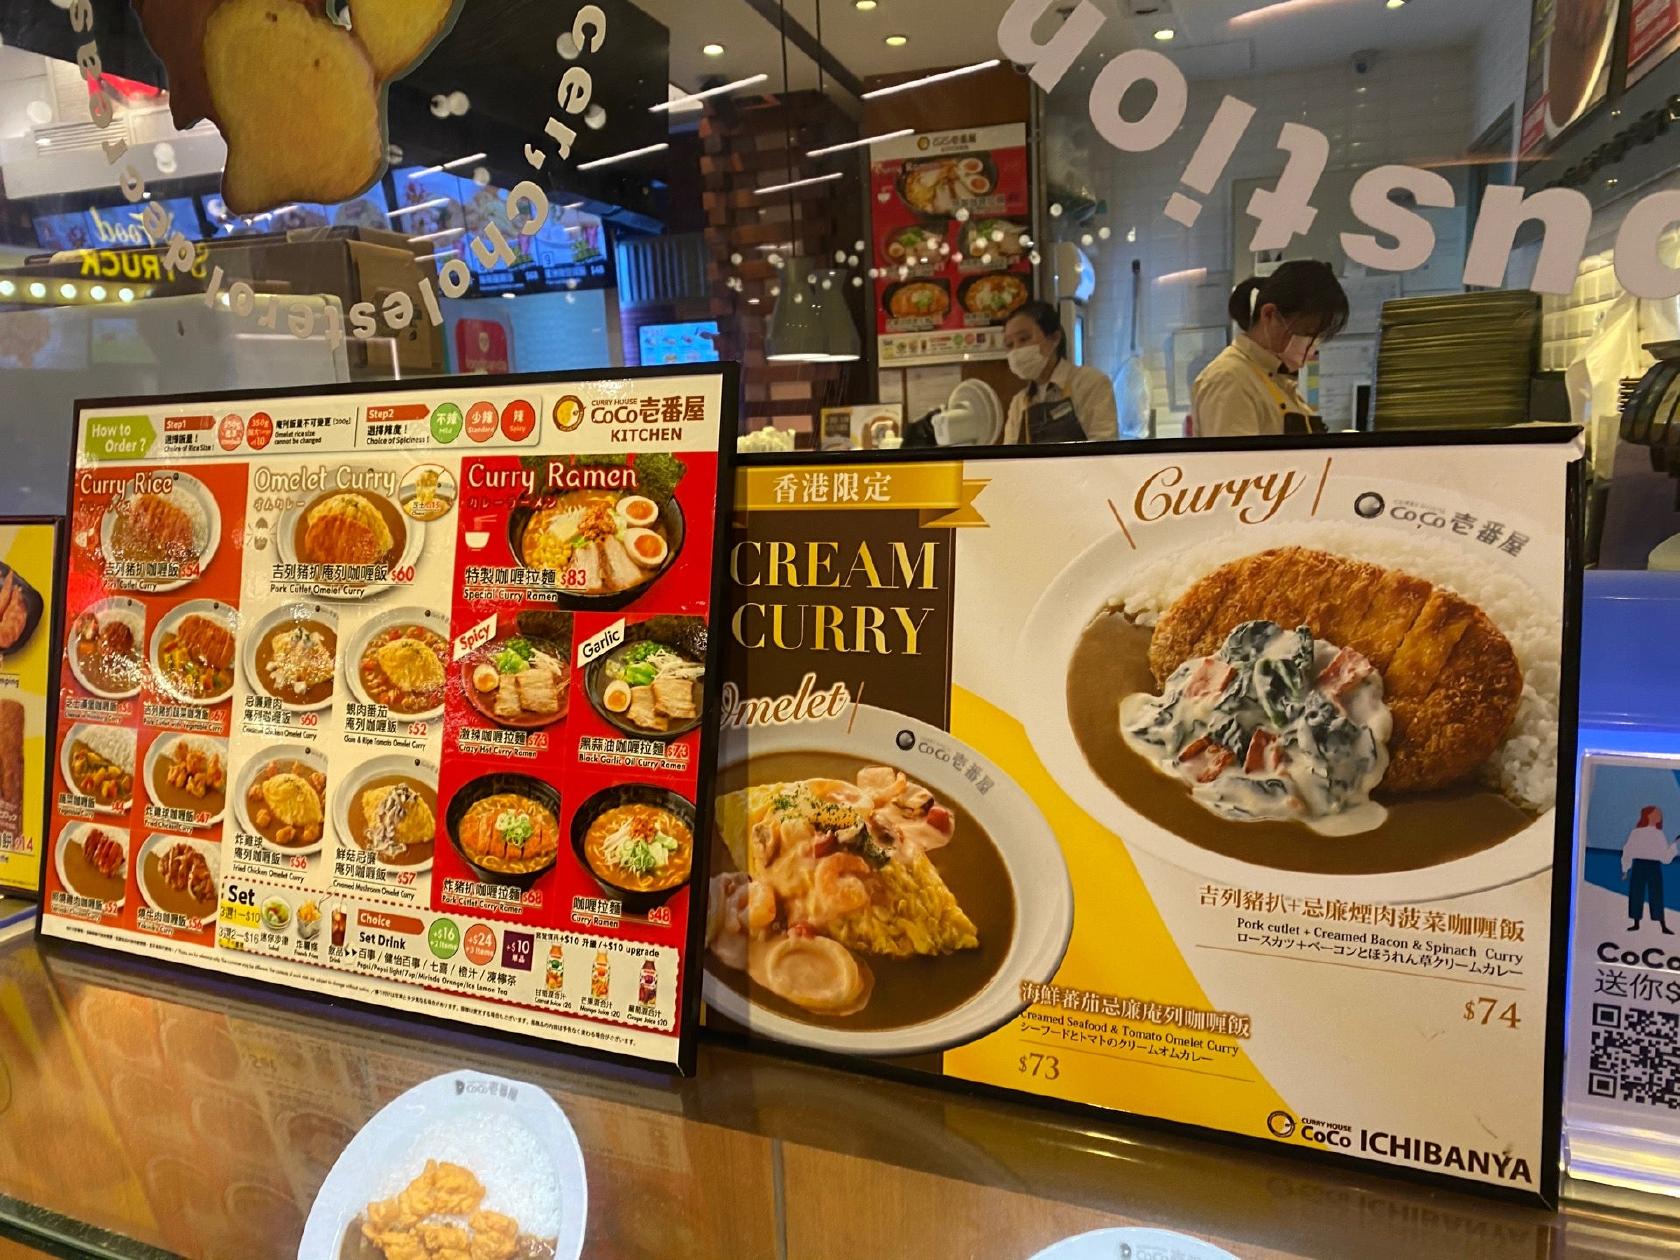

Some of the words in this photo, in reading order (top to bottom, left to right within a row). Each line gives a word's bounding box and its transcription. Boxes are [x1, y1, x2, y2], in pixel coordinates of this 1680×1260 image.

[368, 409, 395, 419] Step2
[91, 424, 117, 438] How
[119, 424, 132, 435] to
[166, 419, 187, 429] Step1
[366, 436, 388, 445] Choice
[611, 428, 682, 442] KITCHEN
[104, 439, 137, 453] Order
[80, 473, 126, 499] Curry
[135, 472, 173, 494] Rice
[255, 466, 328, 491] Omelet
[336, 467, 397, 496] Curry
[469, 463, 535, 495] Curry
[548, 462, 639, 488] Ramen
[773, 471, 893, 504] 香港限定
[1134, 466, 1307, 525] Curry
[730, 540, 941, 590] CREAM
[391, 566, 415, 583] $60
[561, 569, 587, 587] $83
[270, 584, 288, 593] Pork
[289, 585, 312, 594] Cutlet
[313, 586, 341, 595] Omelet
[343, 586, 365, 597] Curry
[464, 589, 495, 601] Special
[498, 590, 524, 602] Curry
[527, 591, 558, 601] Ramen
[459, 623, 491, 650] Spicy
[731, 603, 935, 656] CURRY
[582, 628, 621, 658] Garlic
[301, 713, 318, 727] $60
[302, 731, 317, 741] Curry
[408, 723, 427, 737] $52
[528, 733, 548, 747] $73
[493, 745, 513, 757] Curry
[514, 748, 537, 757] Ramen
[667, 743, 689, 758] $73
[579, 753, 599, 763] Black
[600, 755, 622, 766] Garlic
[624, 757, 636, 766] Oil
[637, 758, 659, 770] Curry
[660, 760, 686, 770] Ramen
[290, 856, 307, 869] $56
[232, 862, 246, 872] Fried
[247, 865, 268, 876] Chicken
[289, 872, 304, 884] Curry
[397, 872, 416, 886] $57
[228, 885, 255, 907] Set
[400, 889, 415, 900] Curry
[523, 890, 542, 905] $68
[442, 894, 457, 904] Pork
[458, 897, 477, 908] Cutlet
[477, 900, 498, 913] Curry
[499, 903, 522, 914] Ramen
[360, 913, 391, 928] Choice
[571, 913, 592, 926] Curry
[593, 916, 619, 928] Ramen
[648, 908, 671, 923] $48
[359, 931, 376, 944] Set
[378, 935, 406, 950] Drink
[433, 927, 455, 941] +$16
[468, 933, 492, 947] +$24
[507, 940, 530, 955] +$10
[1237, 918, 1264, 931] Pork
[1267, 920, 1300, 936] cutlet
[1313, 926, 1368, 945] Creamed
[1371, 933, 1410, 950] Bacon
[1412, 939, 1422, 951] &
[1425, 940, 1477, 960] Spinach
[1485, 948, 1524, 966] Curry
[626, 946, 660, 958] upgrade
[496, 985, 508, 996] Tea
[1462, 996, 1521, 1029] $74
[1019, 1010, 1064, 1026] Creamed
[1066, 1015, 1108, 1033] Seafood
[1110, 1024, 1119, 1034] &
[1122, 1025, 1163, 1042] Tomato
[1165, 1033, 1204, 1049] Omelet
[1207, 1039, 1240, 1057] Curry
[1018, 1052, 1060, 1081] $73
[1301, 1117, 1325, 1128] CURRY
[1326, 1121, 1352, 1132] HOUSE
[1300, 1125, 1351, 1148] CoCo
[1360, 1128, 1533, 1184] ICHIBANYA
